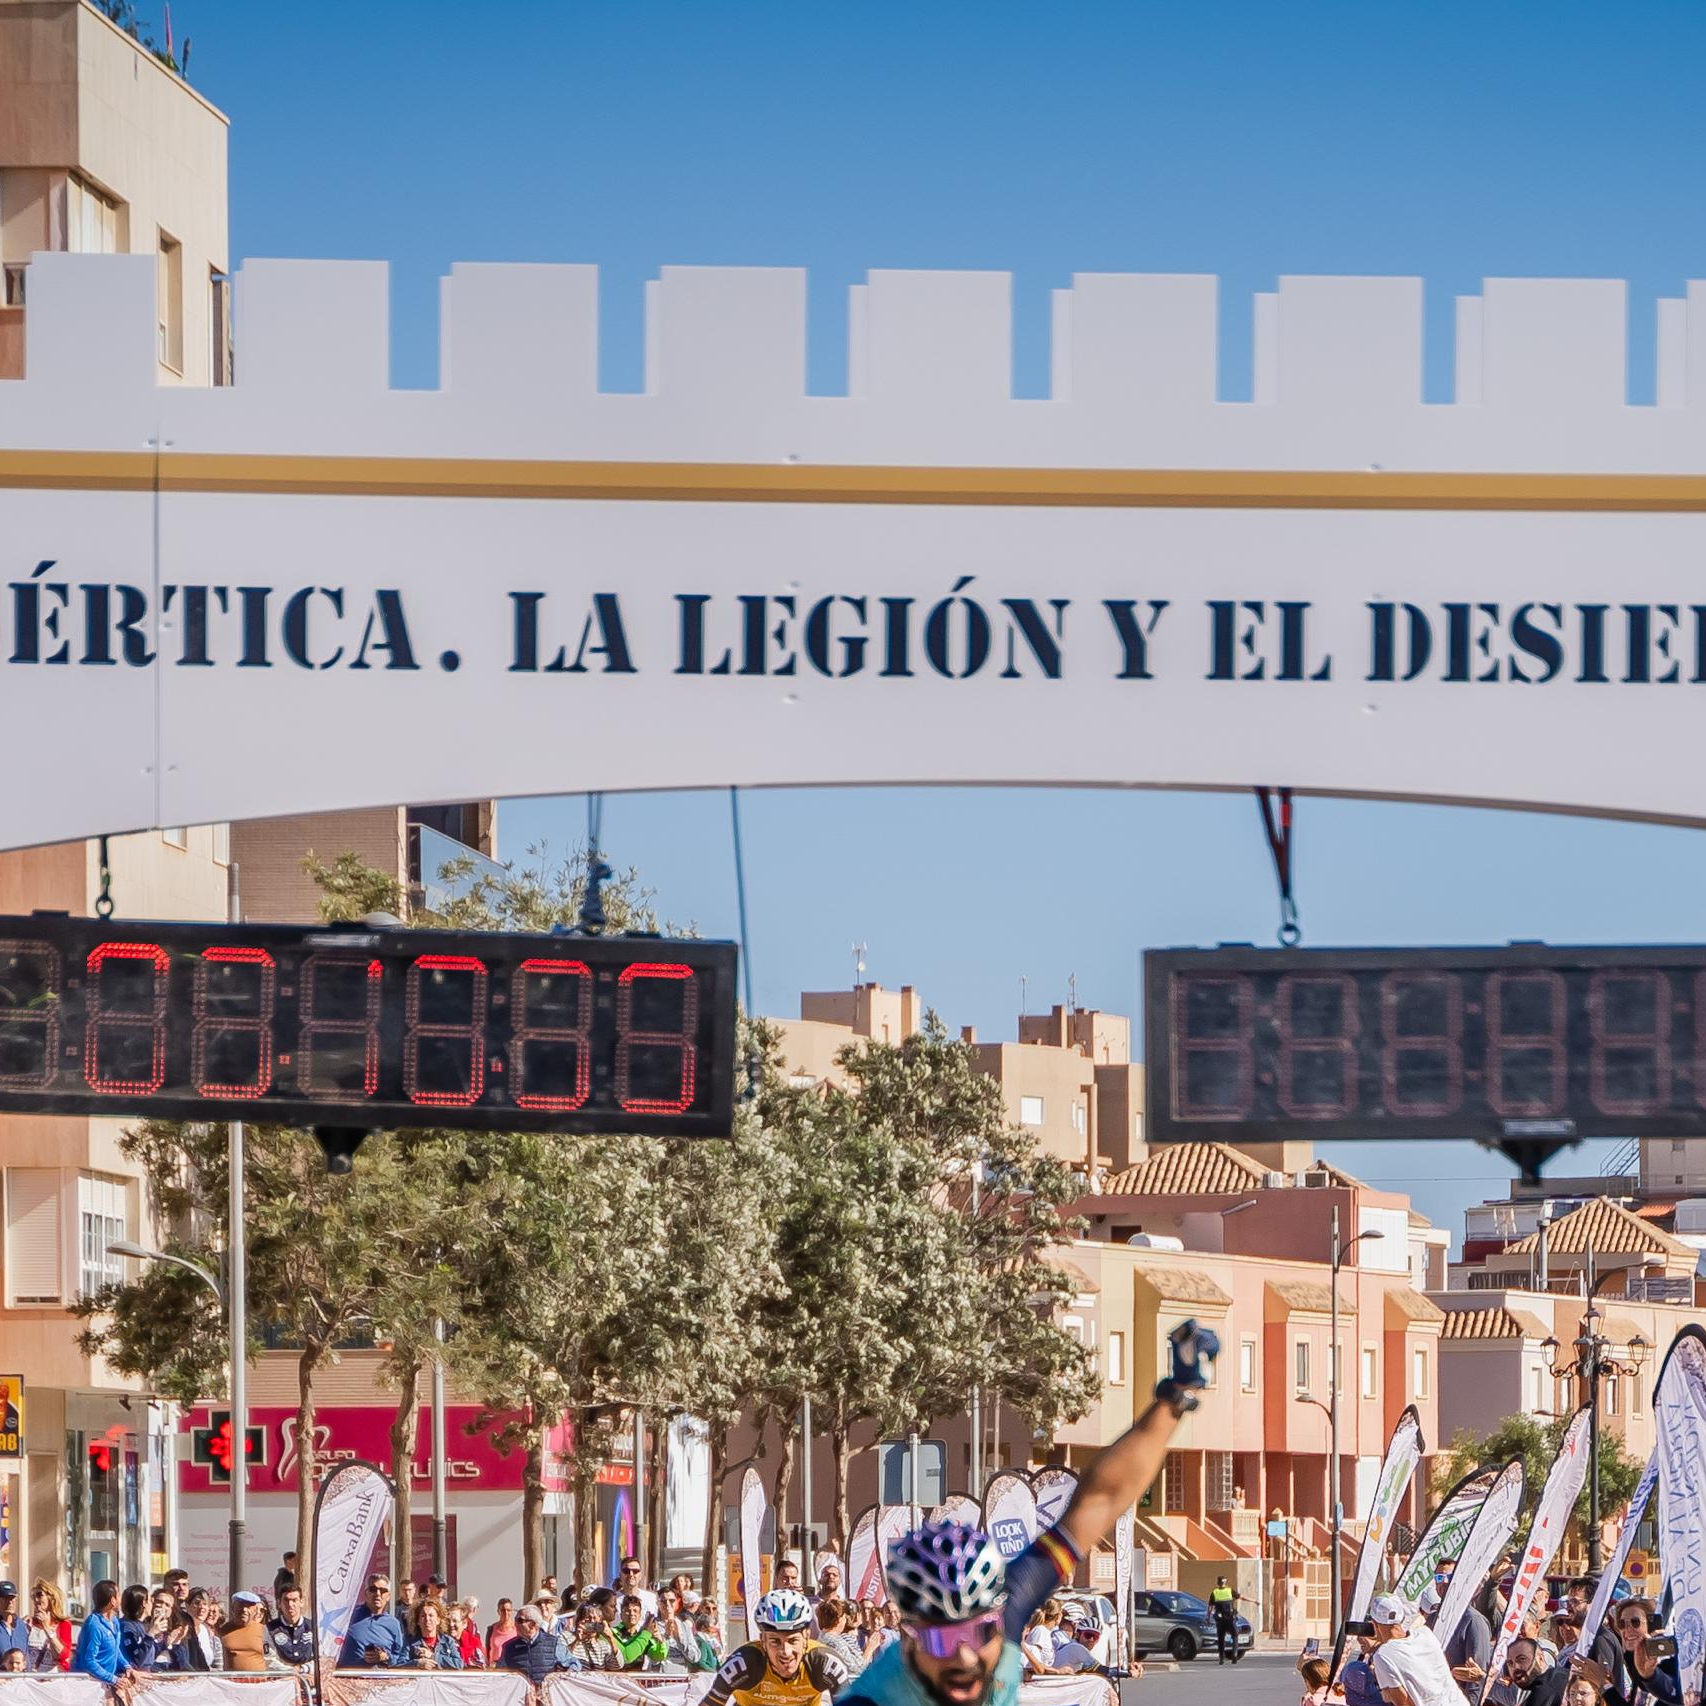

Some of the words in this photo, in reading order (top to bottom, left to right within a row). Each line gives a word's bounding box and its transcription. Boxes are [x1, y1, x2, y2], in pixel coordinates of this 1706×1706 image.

[509, 592, 637, 673] LA
[675, 577, 1069, 678] LEGIÓN
[1104, 601, 1168, 679] Y
[1207, 602, 1330, 680] EL
[327, 1490, 376, 1597] CaixaBank
[995, 1522, 1023, 1538] LOOK
[1000, 1540, 1025, 1555] FIND
